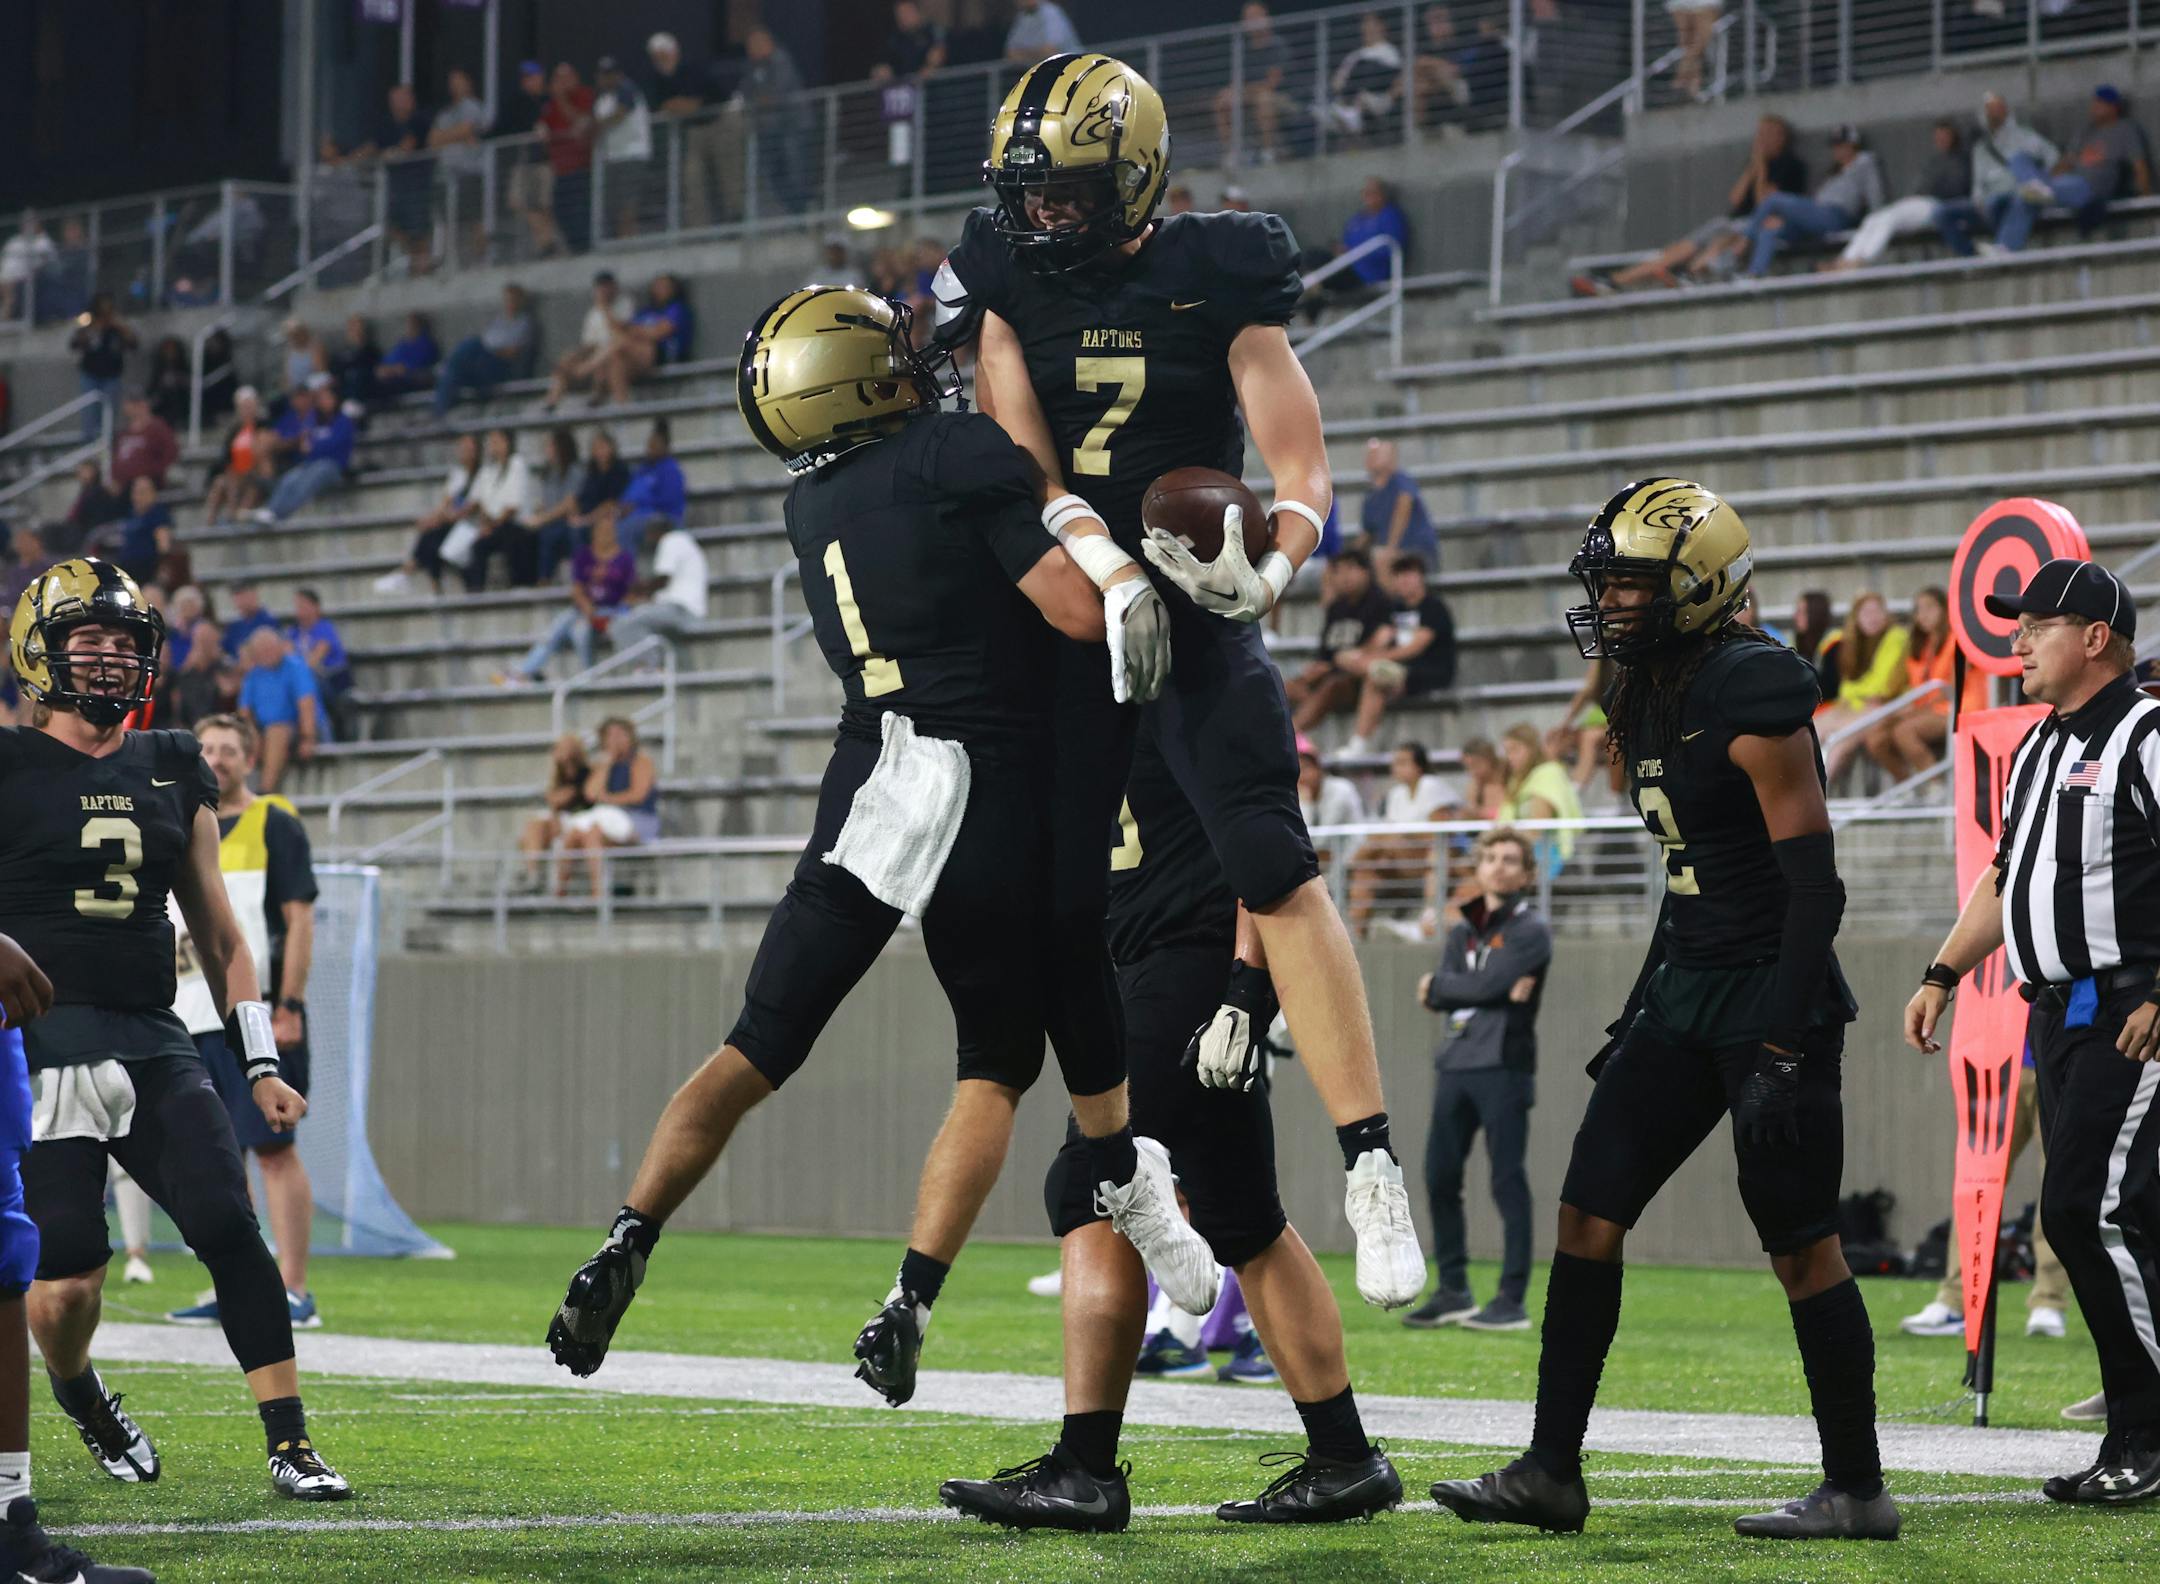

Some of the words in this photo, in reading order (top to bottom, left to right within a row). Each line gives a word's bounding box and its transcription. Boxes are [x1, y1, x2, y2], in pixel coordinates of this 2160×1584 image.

[1081, 329, 1143, 349] RAPTORS
[1072, 356, 1146, 476] 7
[823, 539, 905, 698] 1
[80, 795, 134, 812] RAPTORS
[1638, 786, 1701, 896] 2
[74, 817, 144, 920] 3
[1970, 1189, 1984, 1309] FISHER
